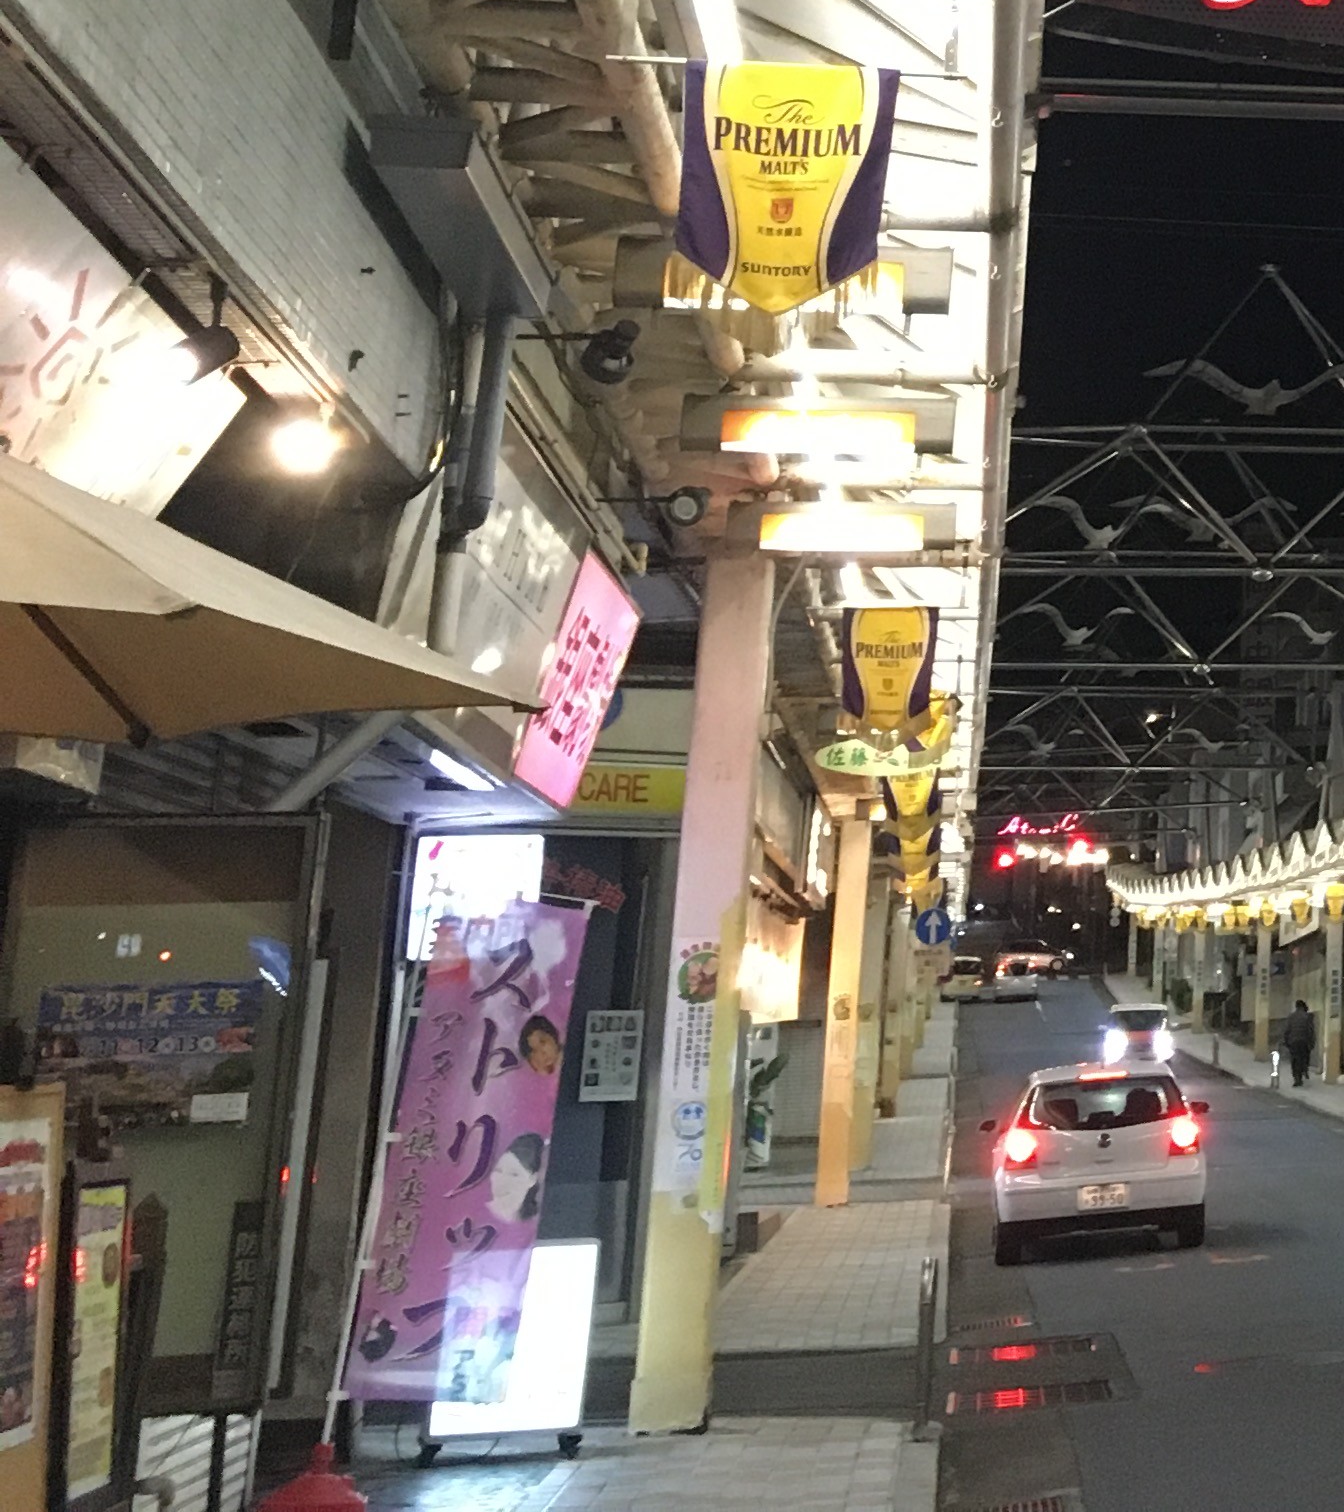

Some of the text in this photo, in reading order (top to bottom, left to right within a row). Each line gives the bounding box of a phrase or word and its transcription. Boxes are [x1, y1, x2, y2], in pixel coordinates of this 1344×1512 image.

[752, 94, 825, 126] The
[713, 116, 863, 159] PREMIUM
[758, 159, 810, 176] MALT'S
[740, 261, 813, 277] SUNTORY
[855, 642, 924, 659] PREMIUM
[578, 771, 651, 804] CARE
